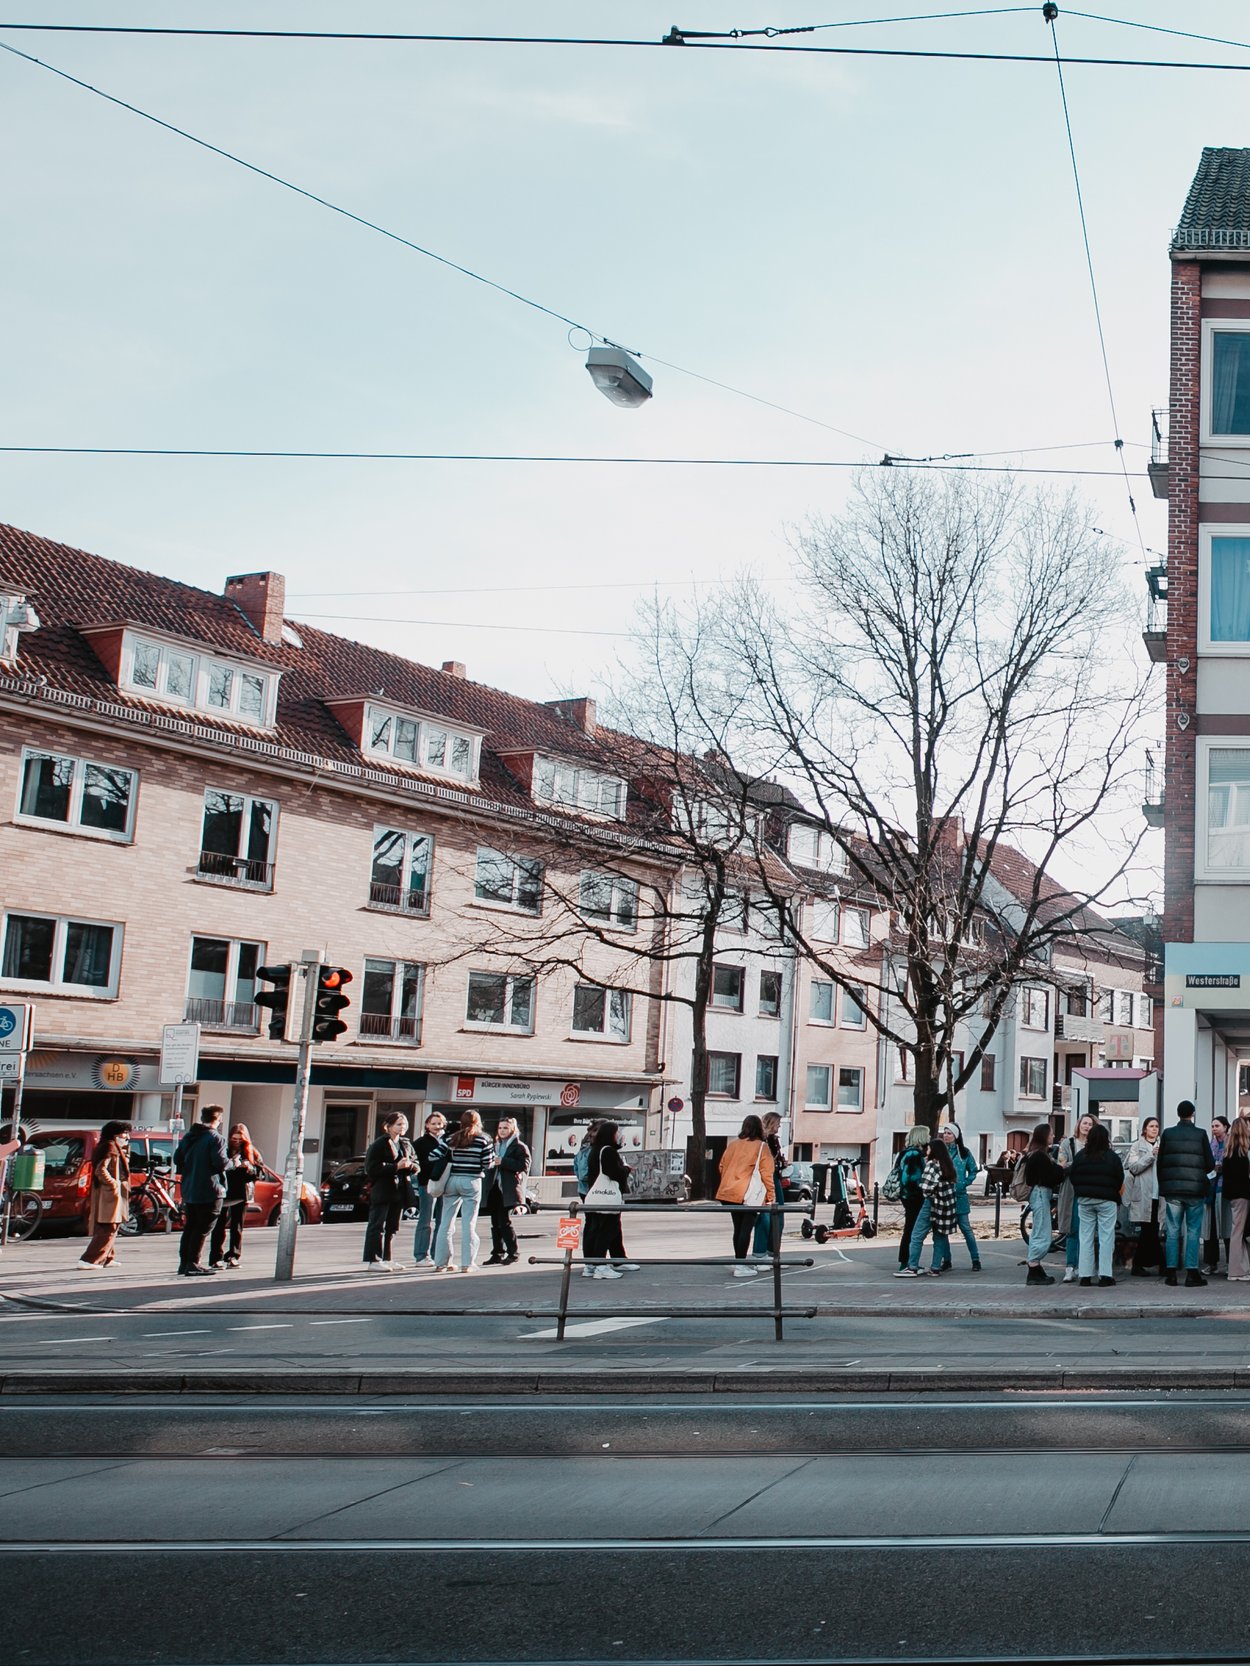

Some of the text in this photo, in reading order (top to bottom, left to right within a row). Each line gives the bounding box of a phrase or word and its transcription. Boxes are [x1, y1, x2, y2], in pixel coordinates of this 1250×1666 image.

[1187, 975, 1239, 986] Westerstraße
[0, 1060, 17, 1071] rei
[457, 1088, 472, 1097] SPD
